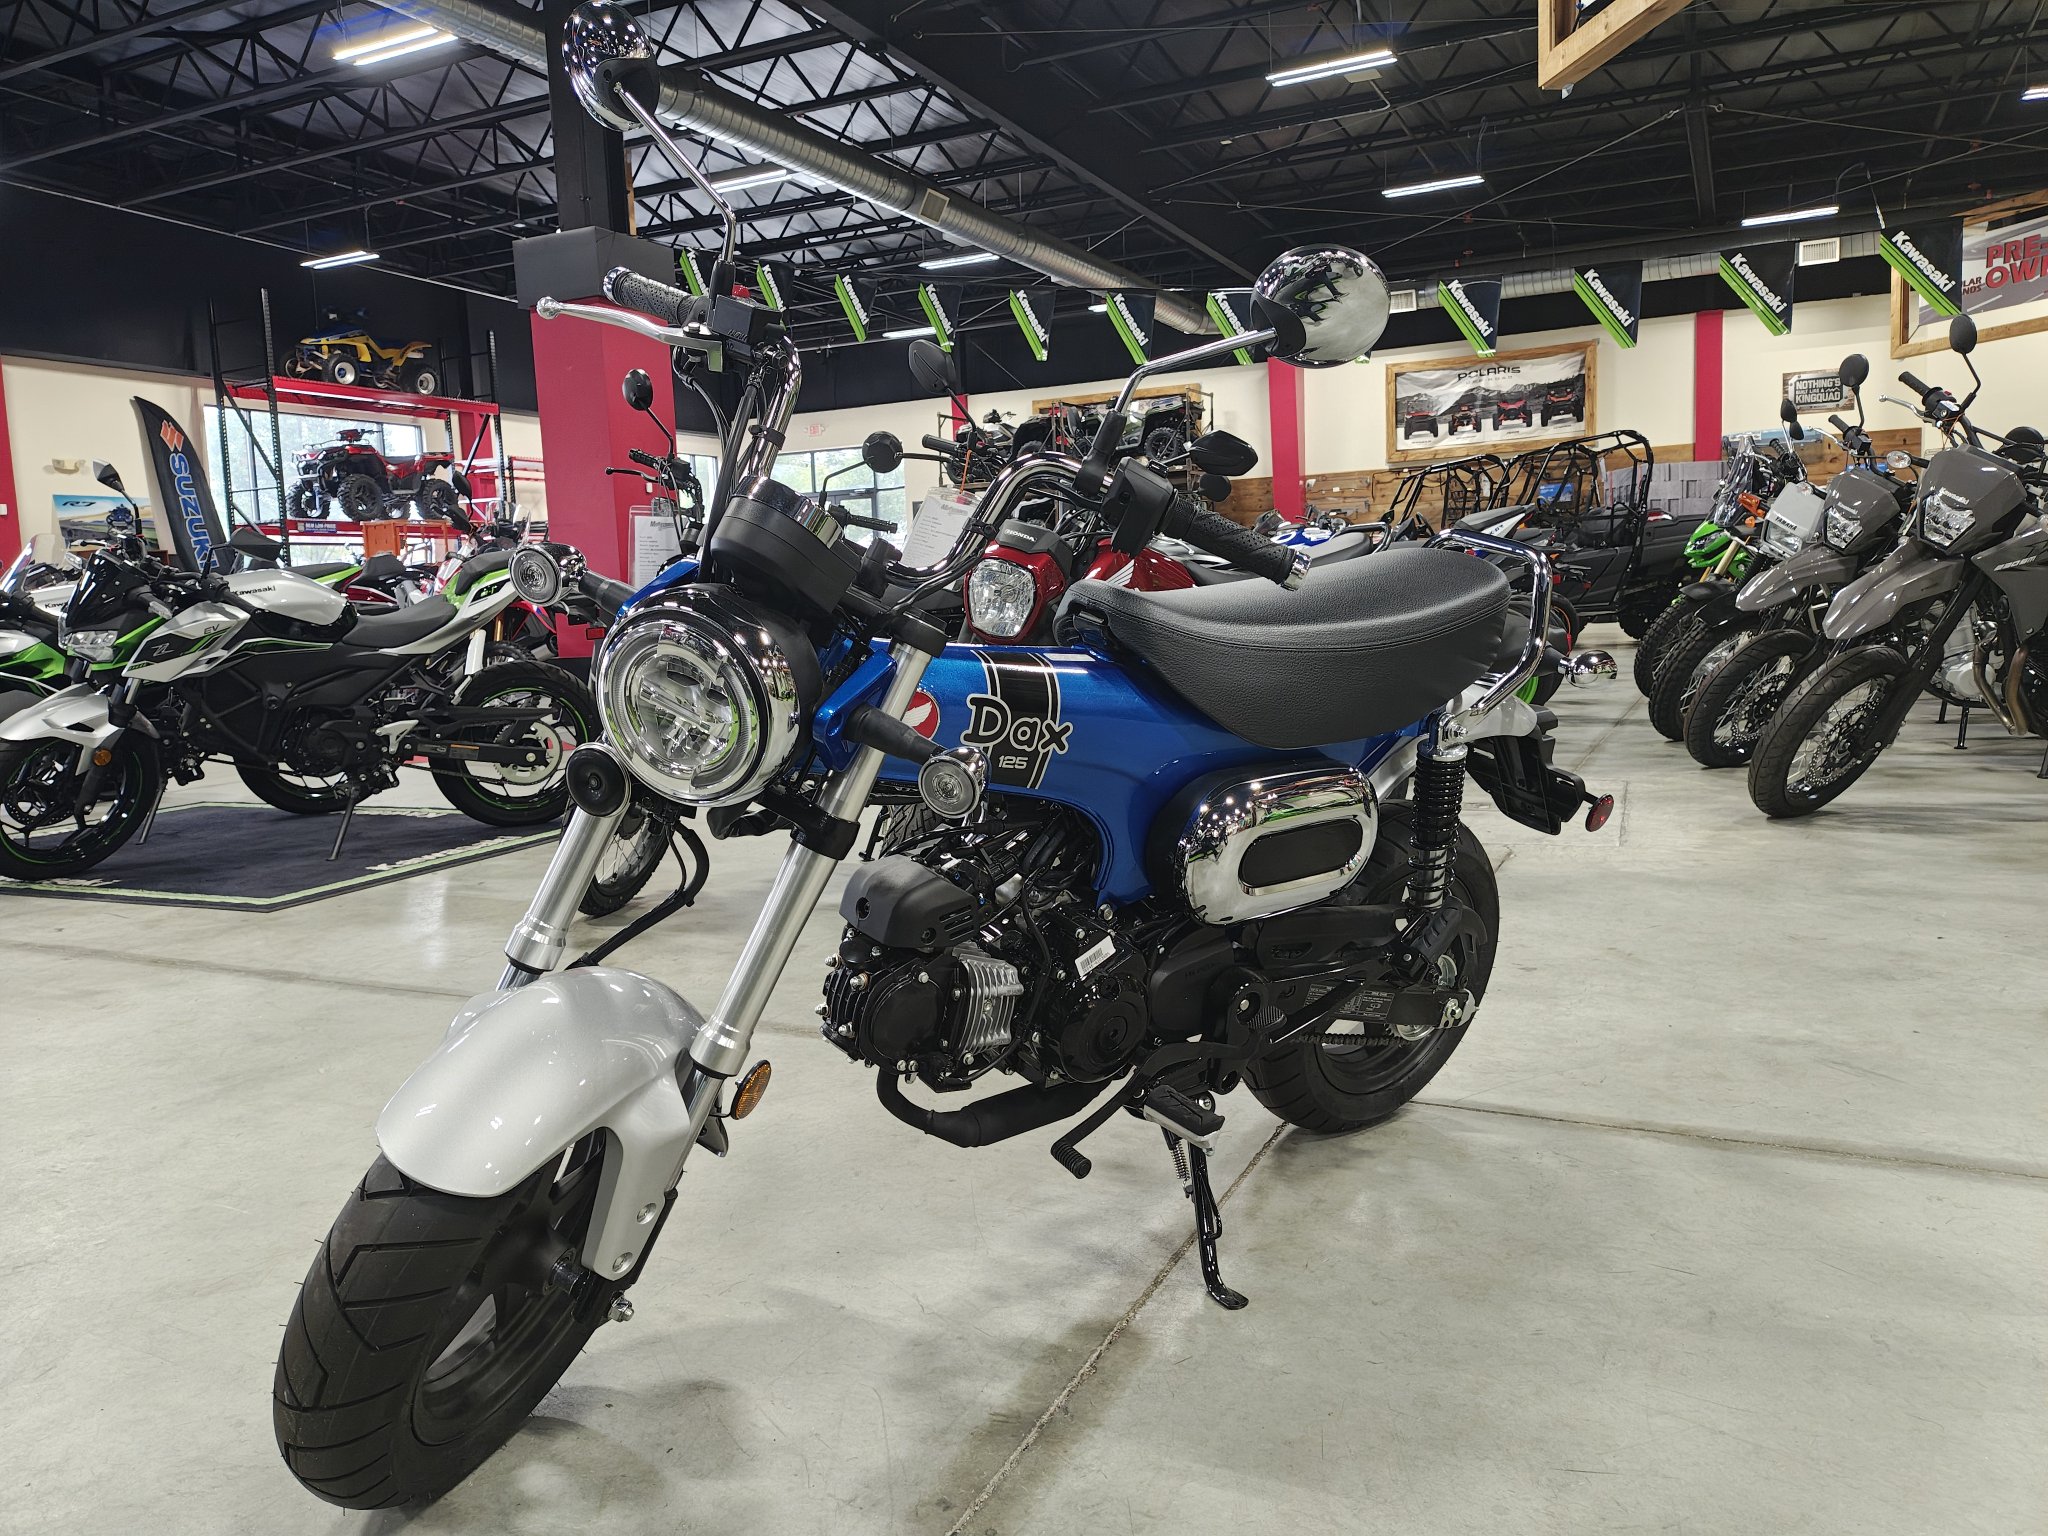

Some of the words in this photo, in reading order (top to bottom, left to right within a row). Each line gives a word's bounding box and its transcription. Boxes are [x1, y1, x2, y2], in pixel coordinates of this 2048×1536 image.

[1730, 253, 1787, 315] Kawasaki
[1892, 231, 1956, 293] Kawasaki
[762, 264, 786, 312] Kawasaki
[842, 275, 869, 325] Kawasaki
[926, 284, 954, 335] Kawasaki
[1448, 279, 1493, 337] Kawasaki
[1584, 269, 1634, 327] Kawasaki
[1016, 290, 1049, 342] Kawasaki
[1114, 293, 1149, 346] Kawasaki
[1215, 292, 1248, 336] Kawasa
[1458, 367, 1520, 381] POLARIS
[1796, 378, 1841, 389] NOTHING'S
[1796, 392, 1841, 404] KINGQUAD
[1004, 529, 1036, 542] HONDA
[1775, 516, 1798, 531] YAMAHA
[203, 624, 220, 635] EV
[960, 693, 1074, 755] Dax
[998, 755, 1029, 770] 125
